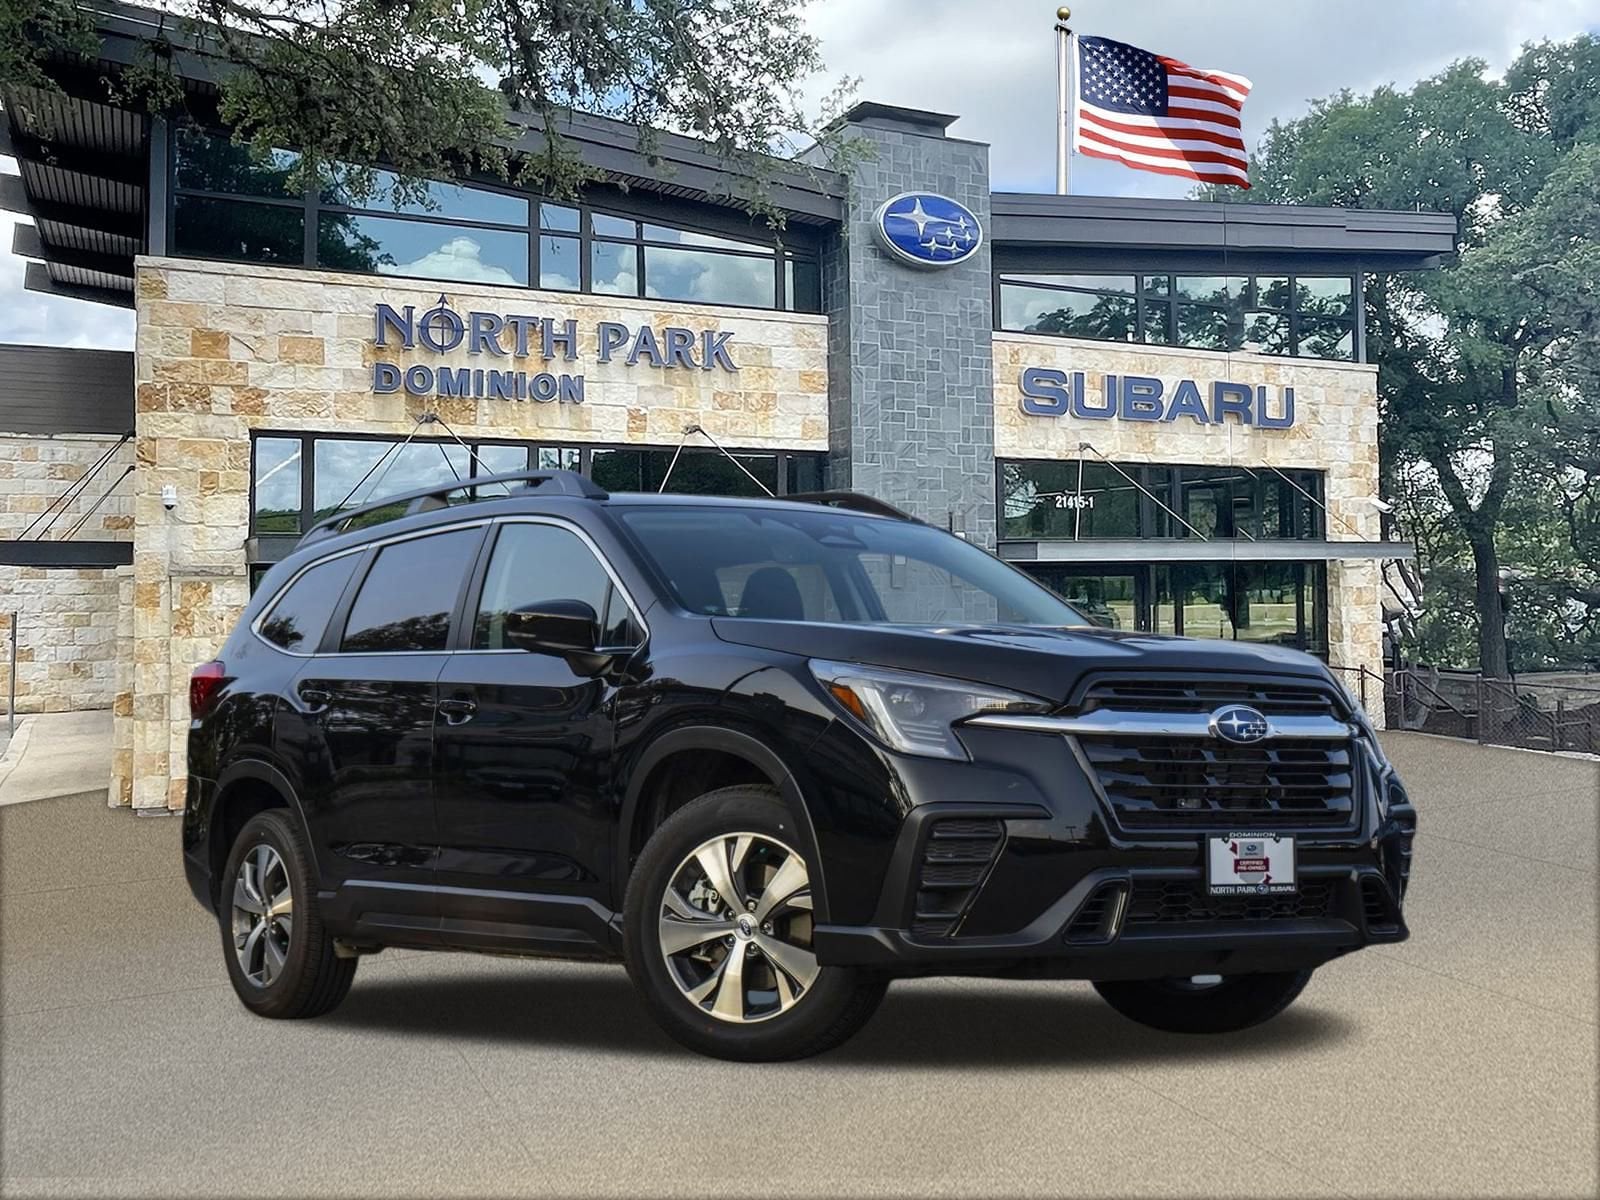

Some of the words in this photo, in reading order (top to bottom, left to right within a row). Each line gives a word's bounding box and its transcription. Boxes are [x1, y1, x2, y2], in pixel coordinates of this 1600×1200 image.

[374, 293, 579, 361] NORTH
[596, 320, 742, 373] PARK
[373, 361, 586, 405] DOMINION
[1018, 366, 1295, 430] SUBARU
[1210, 886, 1235, 894] NORTH
[1236, 886, 1257, 894] PARK
